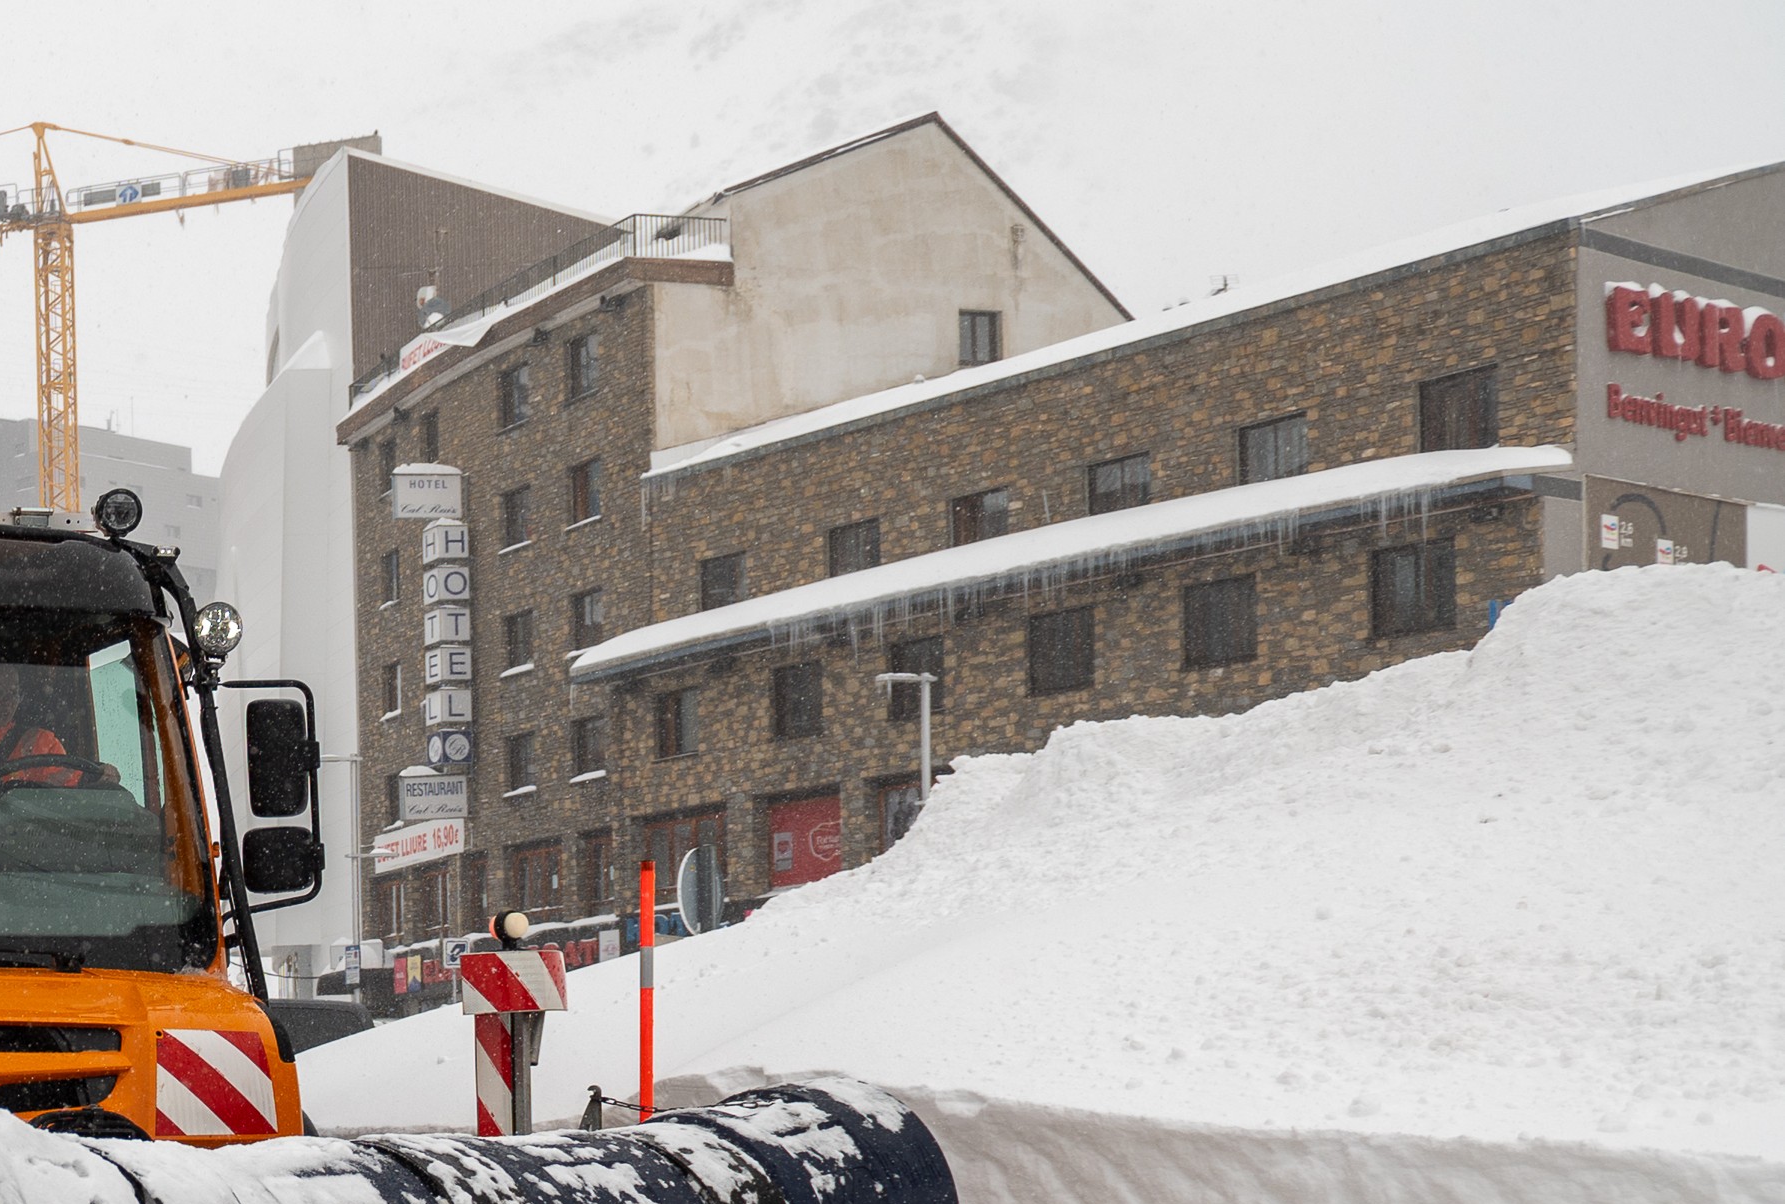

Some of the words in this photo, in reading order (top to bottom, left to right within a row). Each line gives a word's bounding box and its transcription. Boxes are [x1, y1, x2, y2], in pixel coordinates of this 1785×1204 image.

[1605, 284, 1785, 380] EURO
[1607, 383, 1709, 441] Benvingut
[409, 479, 448, 489] HOTEL
[444, 530, 467, 717] HOTEL
[406, 781, 464, 797] RESTAURANT
[401, 833, 427, 857] LLIURE
